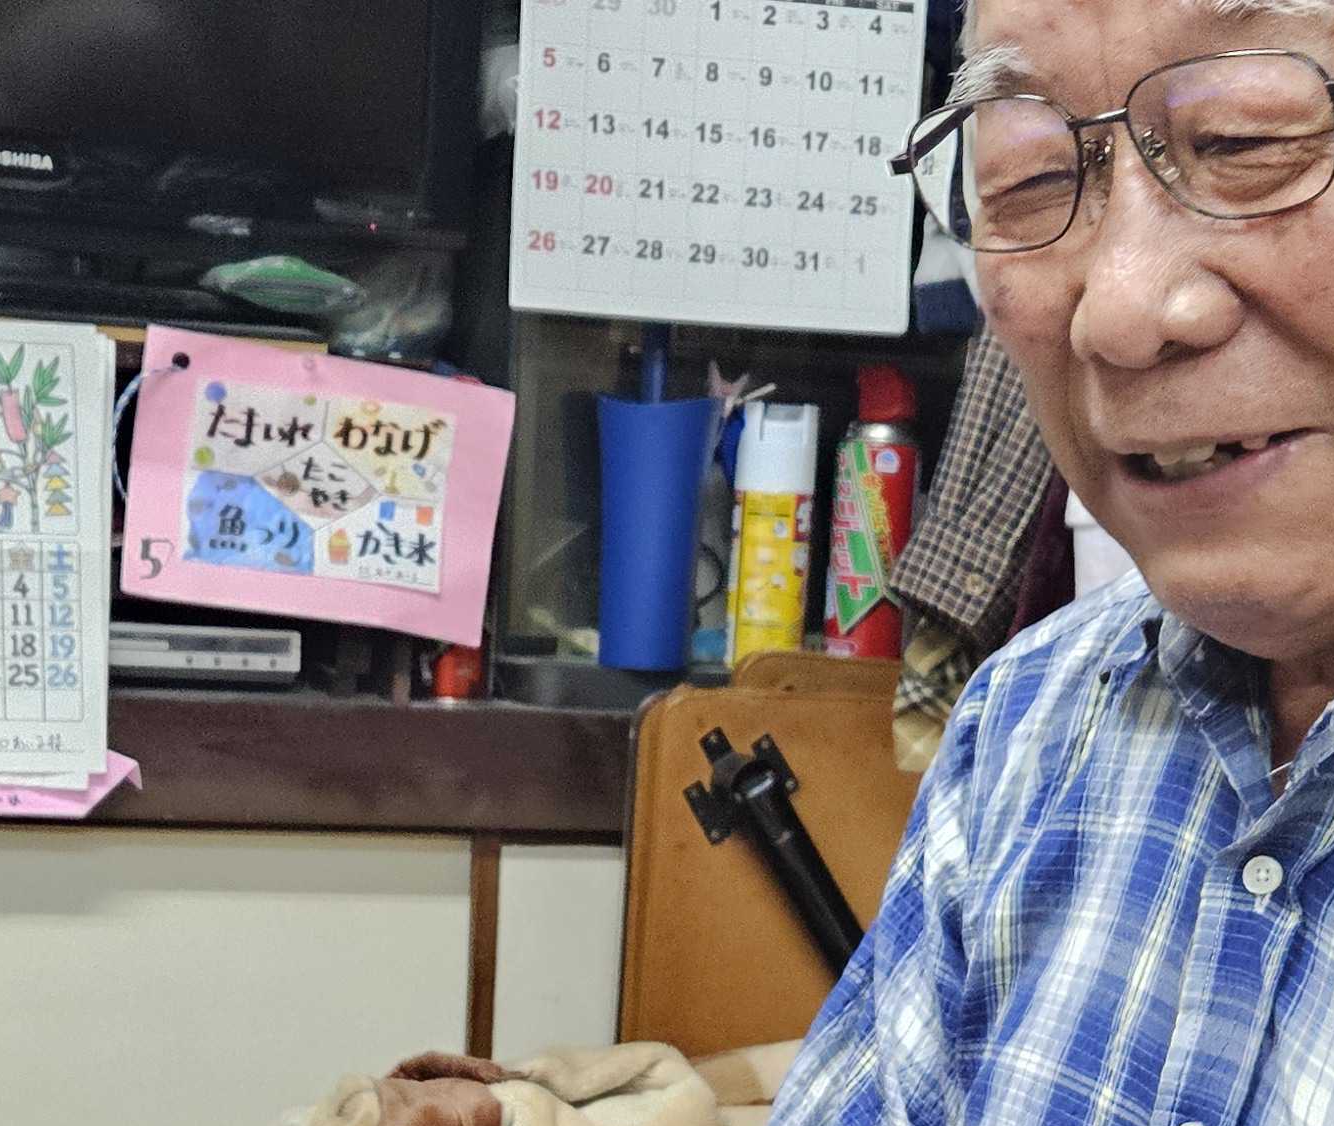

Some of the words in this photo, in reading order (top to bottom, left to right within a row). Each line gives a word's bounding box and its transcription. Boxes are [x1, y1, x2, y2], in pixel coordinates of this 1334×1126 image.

[710, 2, 721, 21] 1
[763, 6, 776, 25] 2
[816, 10, 829, 30] 3
[868, 15, 882, 34] 4
[543, 48, 556, 68] 5
[597, 53, 611, 72] 6
[652, 58, 665, 77] 7
[706, 62, 718, 81] 8
[760, 67, 772, 86] 9
[808, 72, 832, 92] 10
[859, 76, 883, 95] 11
[535, 111, 561, 130] 12
[589, 114, 615, 134] 13
[643, 119, 668, 139] 14
[696, 123, 722, 143] 15
[750, 128, 776, 148] 16
[803, 133, 828, 152] 17
[855, 137, 880, 155] 18
[532, 171, 558, 191] 19
[585, 175, 612, 195] 20
[639, 179, 664, 199] 21
[692, 184, 719, 204] 22
[746, 188, 772, 208] 23
[797, 193, 824, 211] 24
[850, 196, 876, 216] 25
[528, 232, 555, 251] 26
[583, 236, 609, 255] 27
[636, 240, 662, 259] 28
[689, 244, 715, 263] 29
[742, 249, 768, 268] 30
[795, 252, 819, 271] 31
[207, 404, 314, 447] たまいれ
[333, 416, 447, 460] わなげ
[301, 456, 347, 483] たこ
[308, 487, 350, 511] やき
[209, 504, 301, 552] 魚つり
[47, 544, 74, 572] 土
[140, 539, 175, 579] 5
[14, 574, 28, 597] 4
[53, 576, 68, 599] 5
[12, 603, 33, 626] 11
[49, 604, 74, 627] 12
[12, 635, 36, 656] 18
[50, 635, 75, 657] 19
[8, 664, 39, 687] 25
[47, 666, 77, 688] 26
